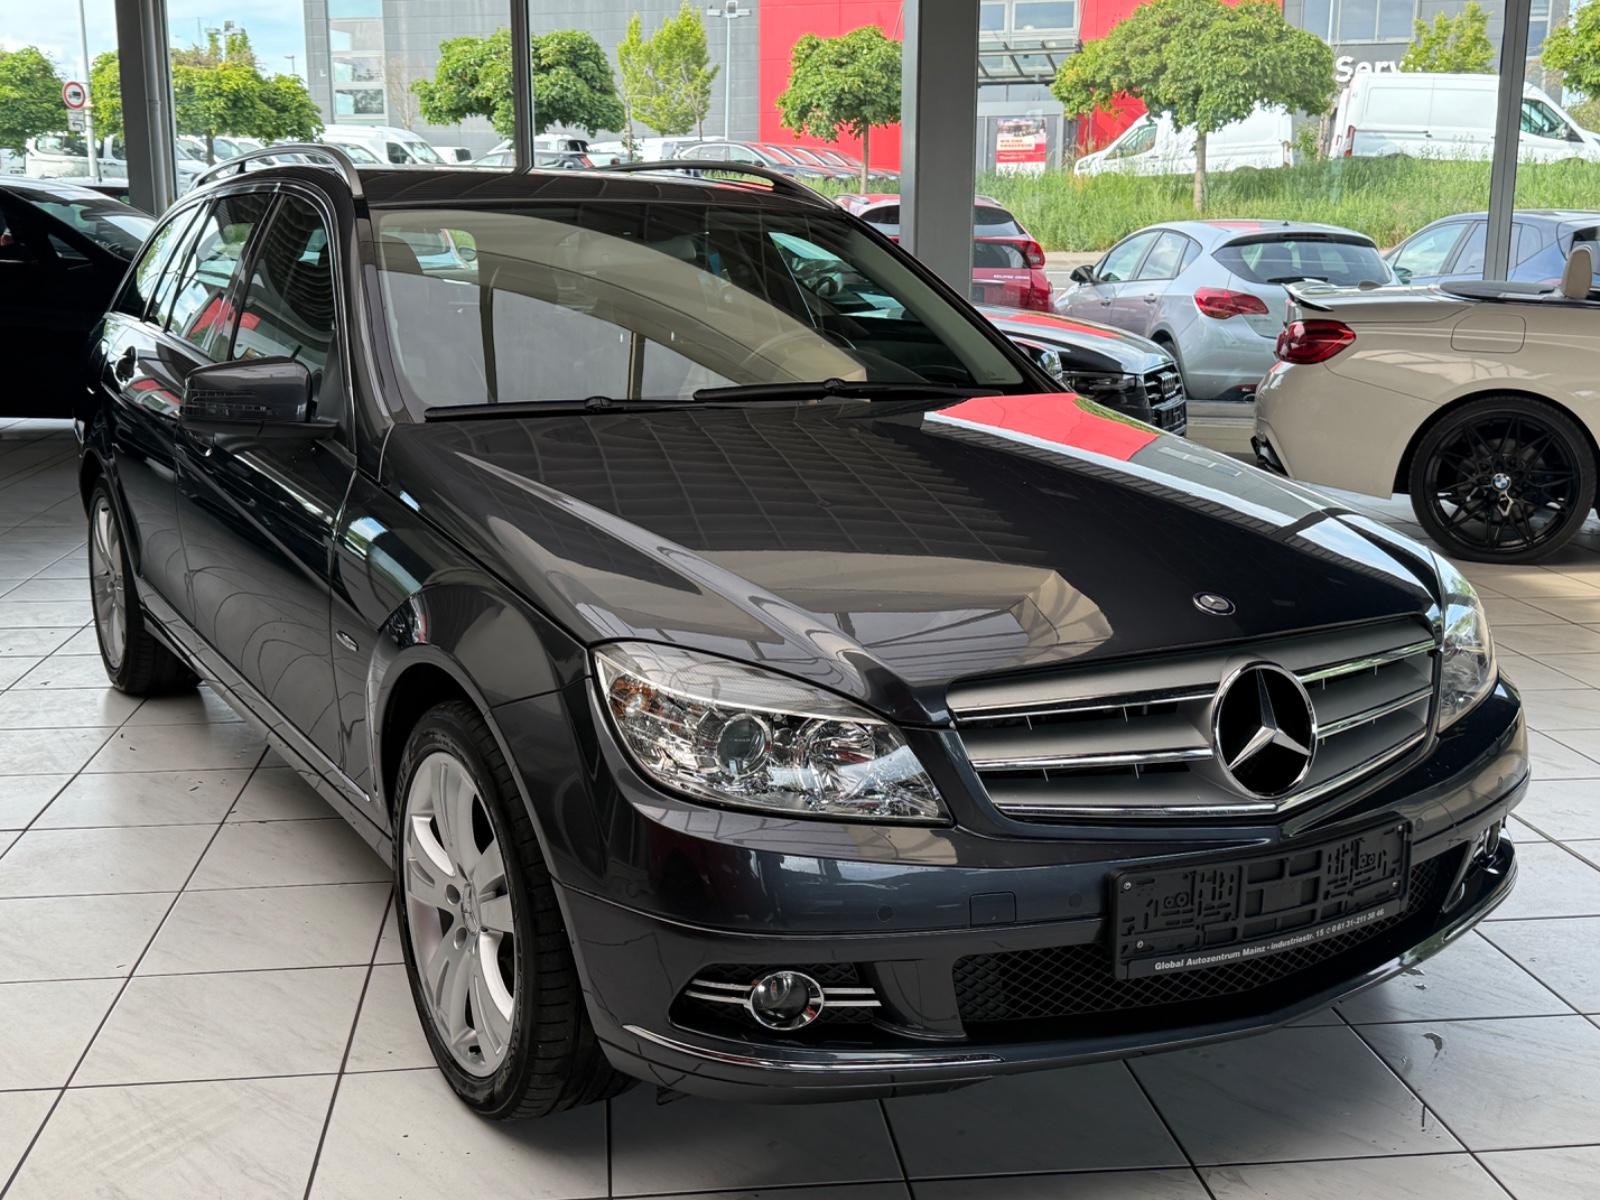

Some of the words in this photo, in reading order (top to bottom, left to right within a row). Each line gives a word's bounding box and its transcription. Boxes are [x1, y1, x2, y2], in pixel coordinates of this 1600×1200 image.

[1155, 959, 1184, 970] Global
[1186, 950, 1240, 966] Autozentrum
[1242, 946, 1266, 957] Mainz
